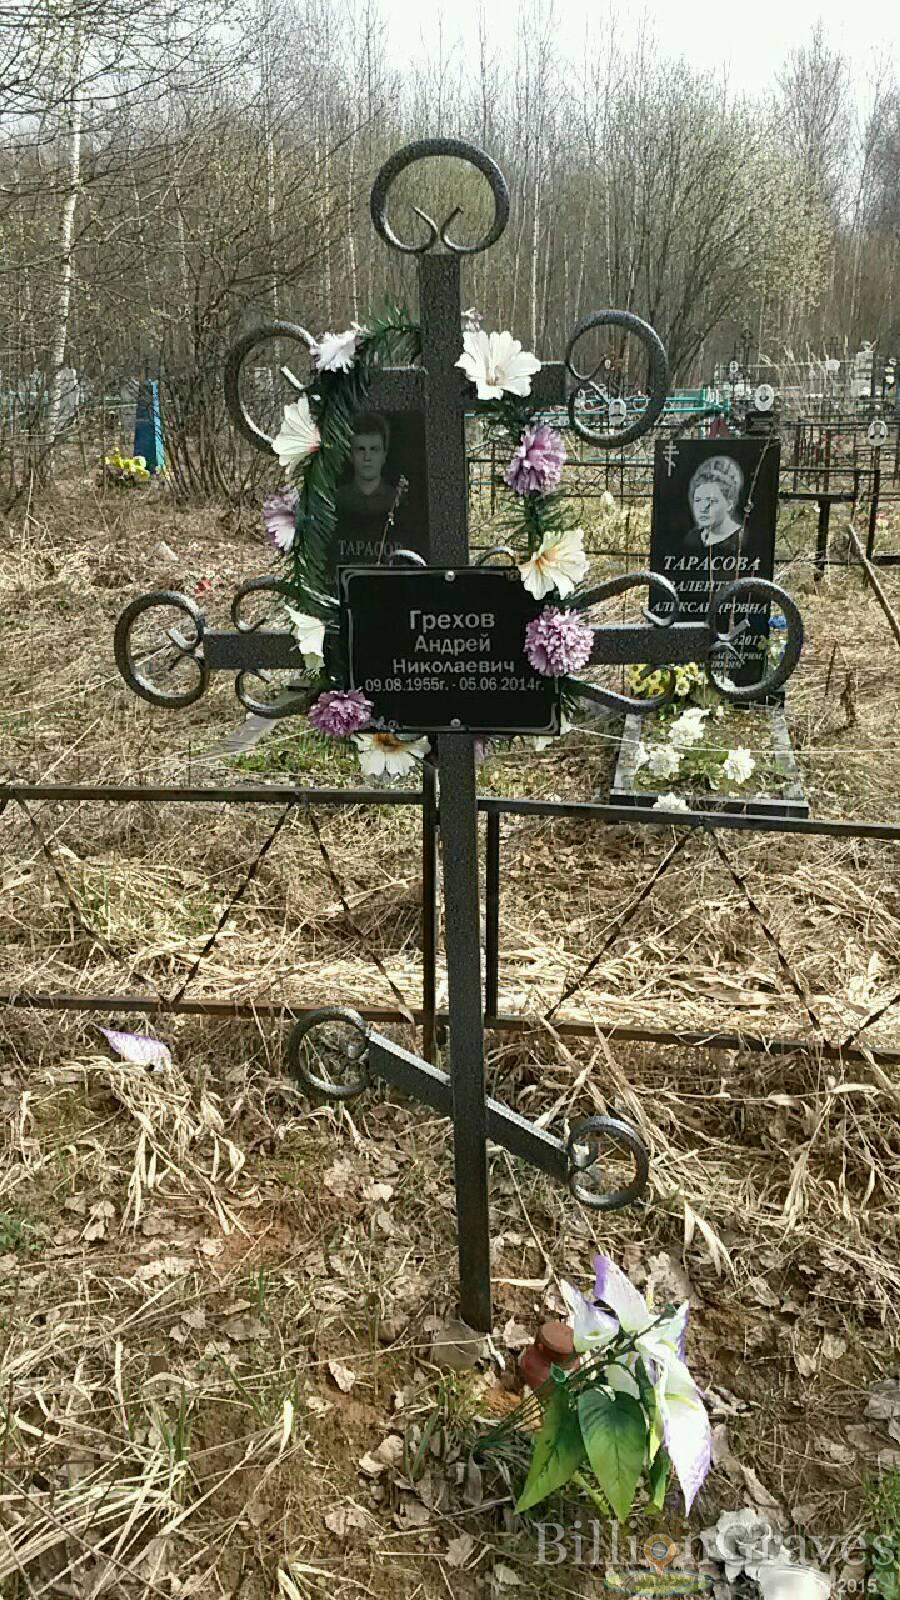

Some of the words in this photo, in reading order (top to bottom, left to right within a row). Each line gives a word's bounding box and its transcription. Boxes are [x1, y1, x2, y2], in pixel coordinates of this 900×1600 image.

[663, 555, 761, 571] ТАРАСОВА
[651, 601, 768, 615] АЛКСАРОВНА
[408, 609, 496, 632] Грехов
[414, 633, 491, 656] Андрей
[392, 658, 515, 674] Николаевич
[364, 677, 449, 692] 09.08.1955г.
[458, 676, 545, 692] 05.06.2014г.
